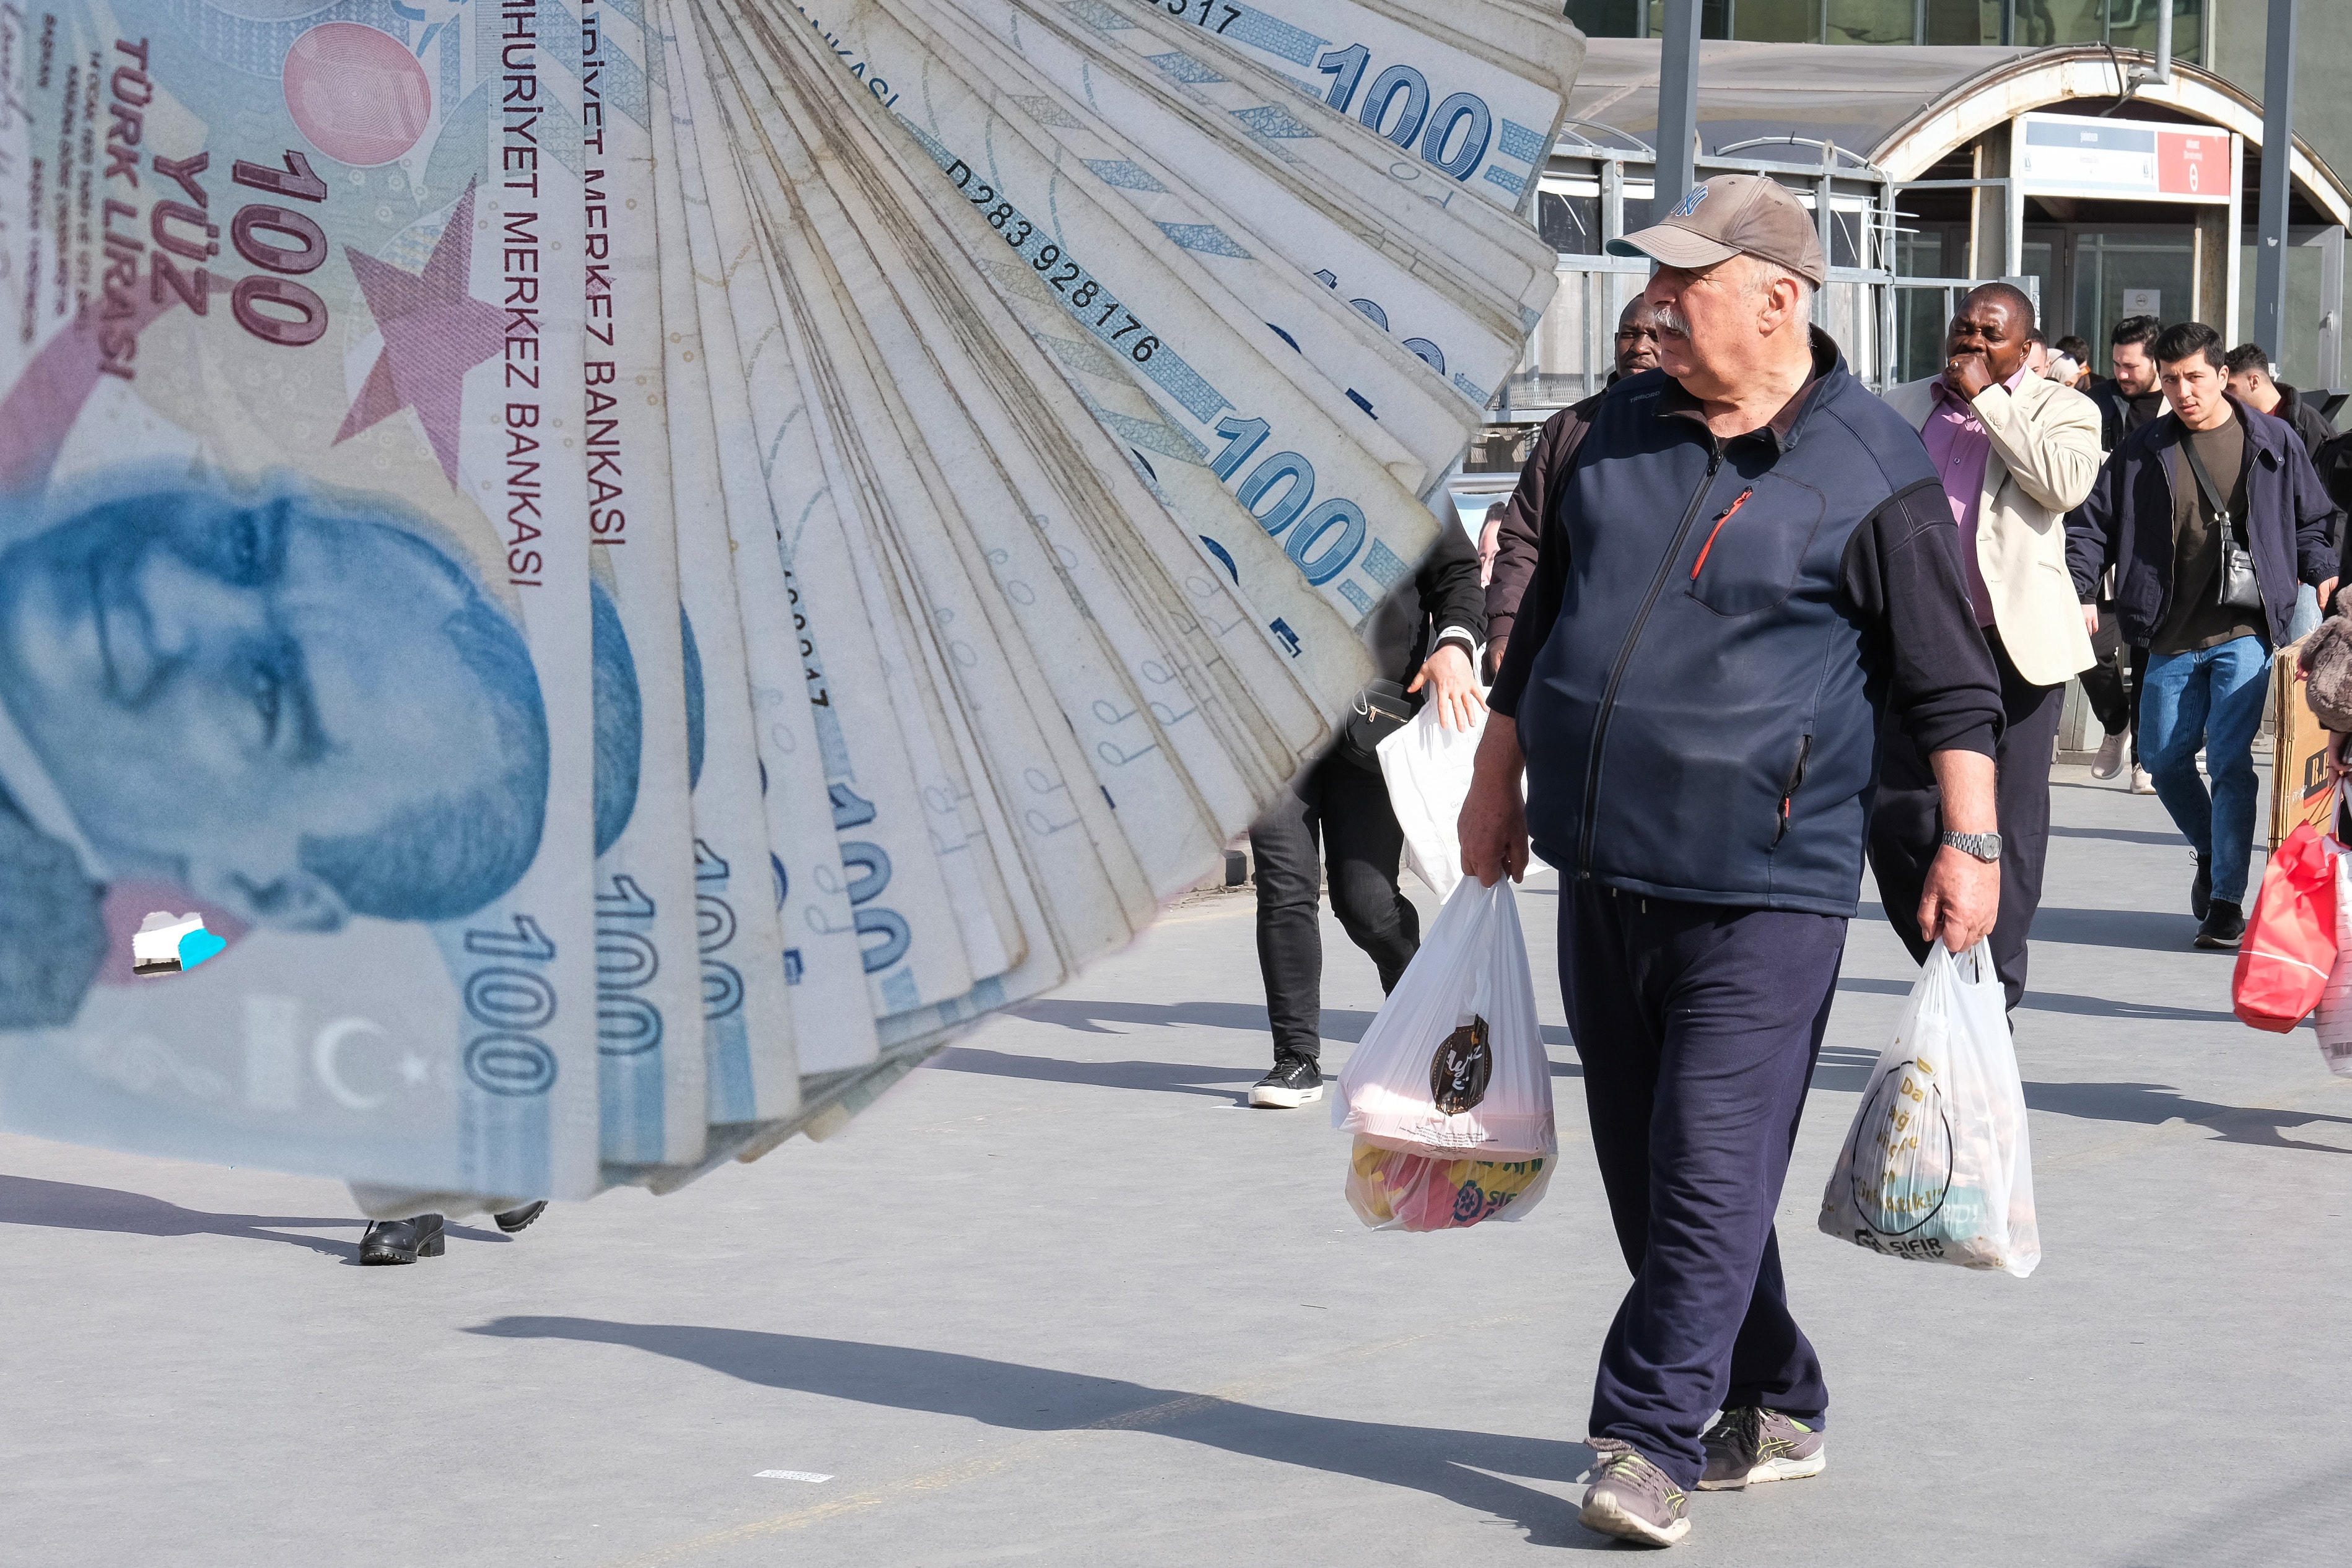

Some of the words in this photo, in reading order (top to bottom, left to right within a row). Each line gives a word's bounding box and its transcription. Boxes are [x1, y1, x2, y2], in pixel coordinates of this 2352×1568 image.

[104, 37, 153, 188] TÜRK
[502, 0, 544, 198] HURİYET
[1317, 43, 1492, 182] 100
[97, 198, 144, 380] LİRASI
[151, 151, 220, 317] YÜZ
[230, 149, 328, 347] 100
[504, 212, 540, 390] MERKEZ
[1033, 244, 1160, 362] 928176
[584, 361, 626, 545] BANKASI
[1629, 391, 1660, 403] TRIBORD
[505, 402, 543, 586] BANKASI
[1209, 416, 1366, 586] 100
[463, 913, 557, 1097] 100
[596, 873, 663, 1055] 100
[1889, 1237, 1944, 1253] SIFIR
